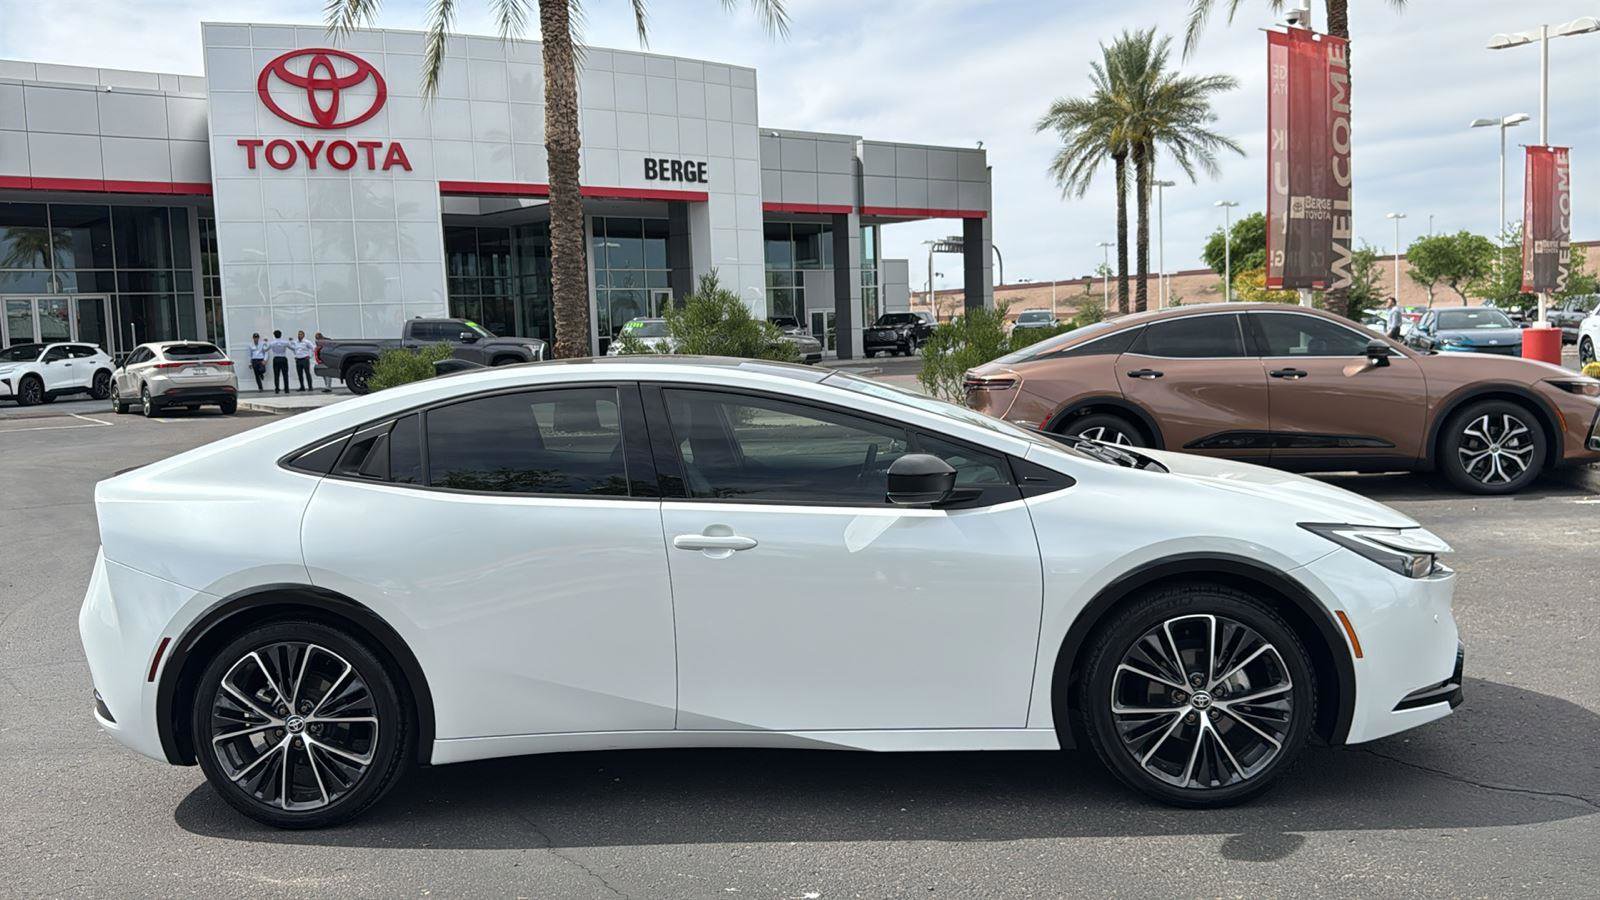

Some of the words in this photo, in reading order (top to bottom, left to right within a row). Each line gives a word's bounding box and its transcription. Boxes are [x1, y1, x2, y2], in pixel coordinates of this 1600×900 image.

[237, 139, 412, 171] TOYOTA
[644, 158, 708, 183] BERGE
[1327, 42, 1352, 292] WELCOME
